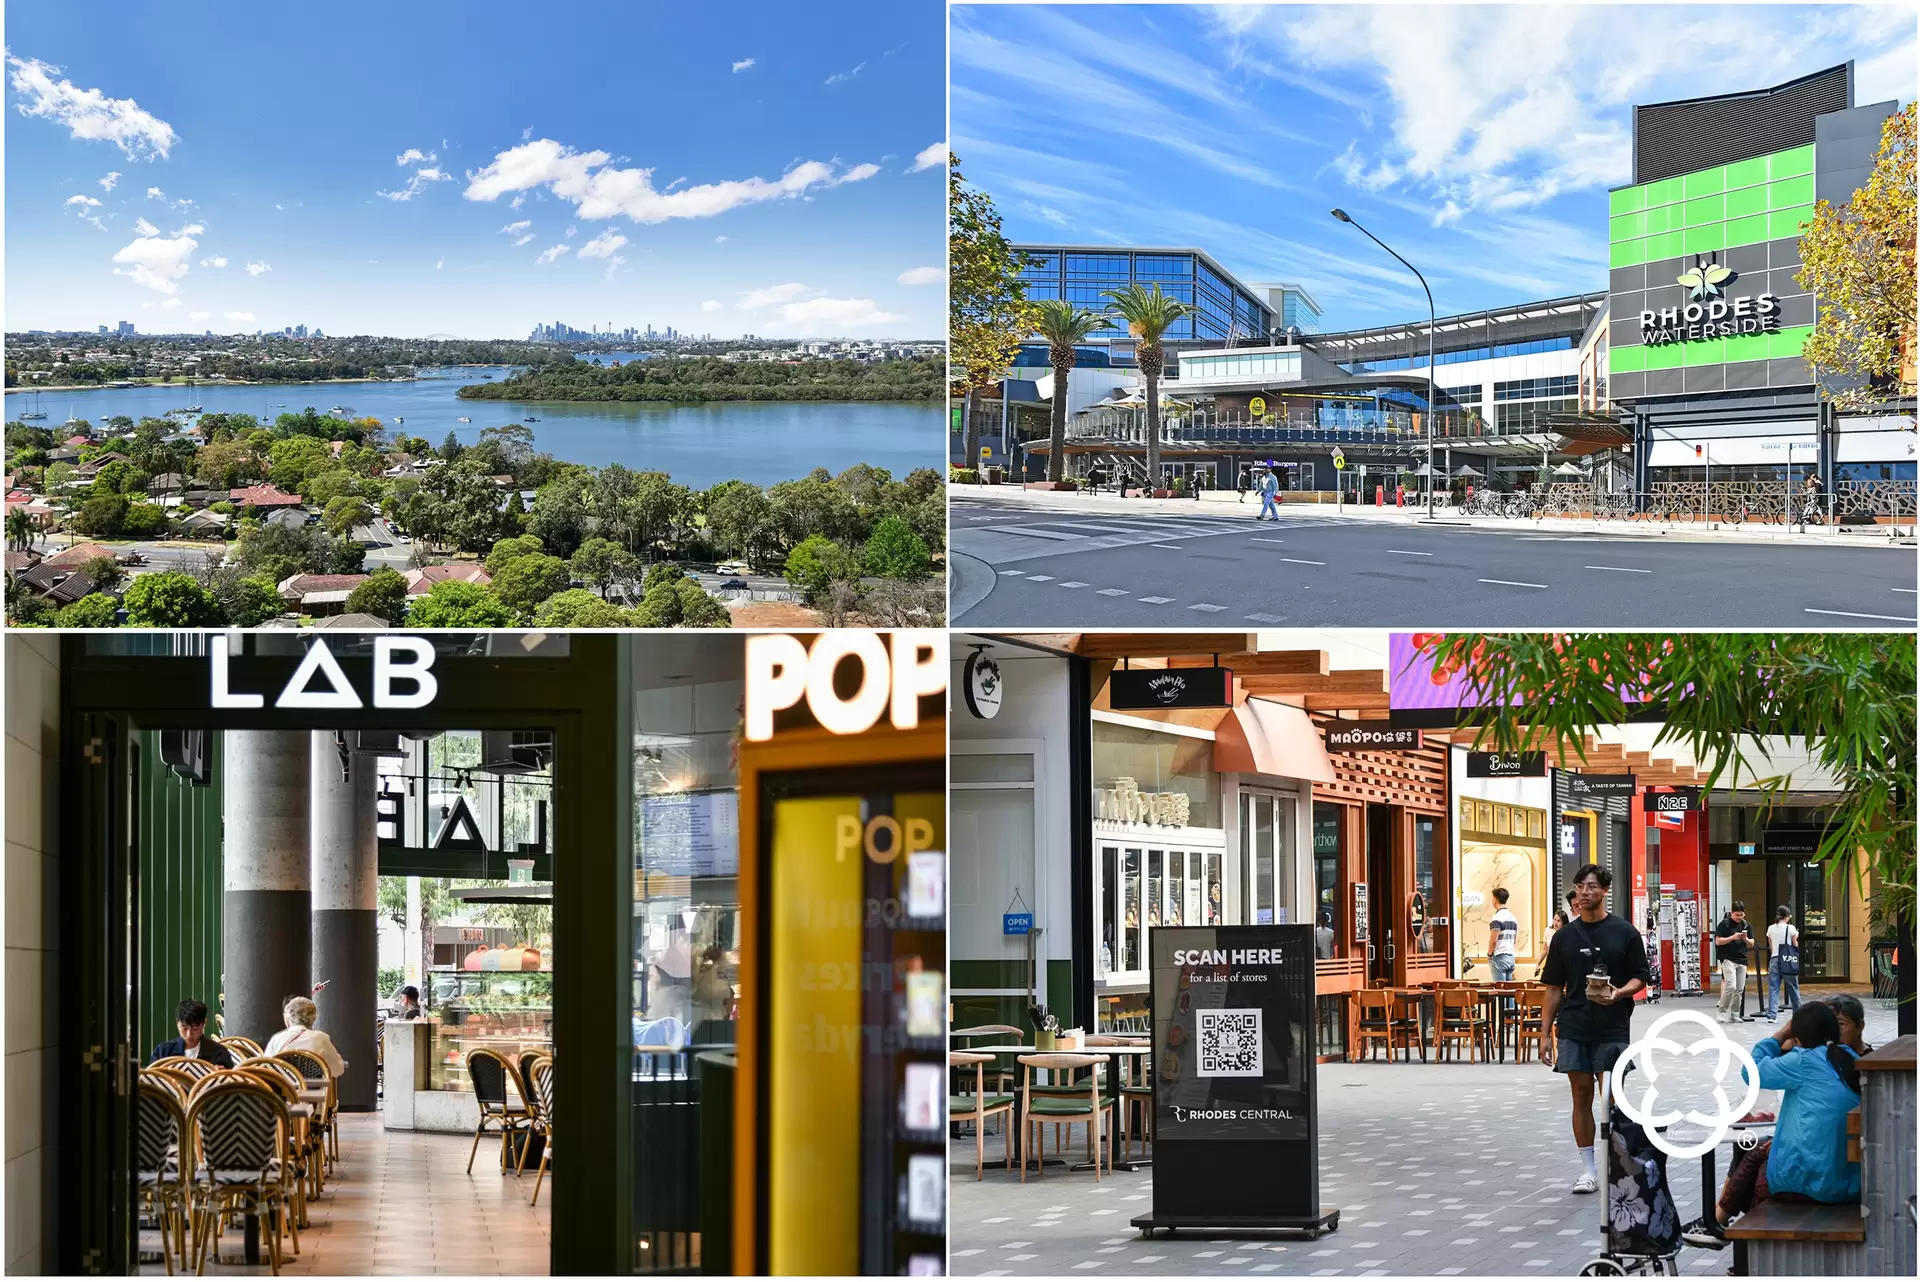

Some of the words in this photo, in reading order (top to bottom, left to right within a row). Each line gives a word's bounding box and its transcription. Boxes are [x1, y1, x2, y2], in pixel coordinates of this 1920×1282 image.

[1640, 293, 1775, 329] RHODES
[1641, 315, 1774, 344] WATERSIDE
[1273, 460, 1298, 468] Burgers
[211, 635, 439, 709] LAB
[745, 632, 947, 742] POP
[1330, 731, 1382, 744] MAOPO
[1489, 754, 1520, 771] Biwon
[1658, 795, 1688, 810] N2E
[836, 814, 934, 865] POP
[1007, 918, 1029, 926] OPEN
[1174, 949, 1227, 966] SCAN
[1231, 949, 1283, 965] HERE
[1190, 972, 1203, 982] for
[1213, 972, 1227, 982] list
[1229, 971, 1240, 982] of
[1241, 974, 1268, 982] stores
[1189, 1110, 1237, 1119] RHODES
[1239, 1109, 1293, 1119] CENTRAL
